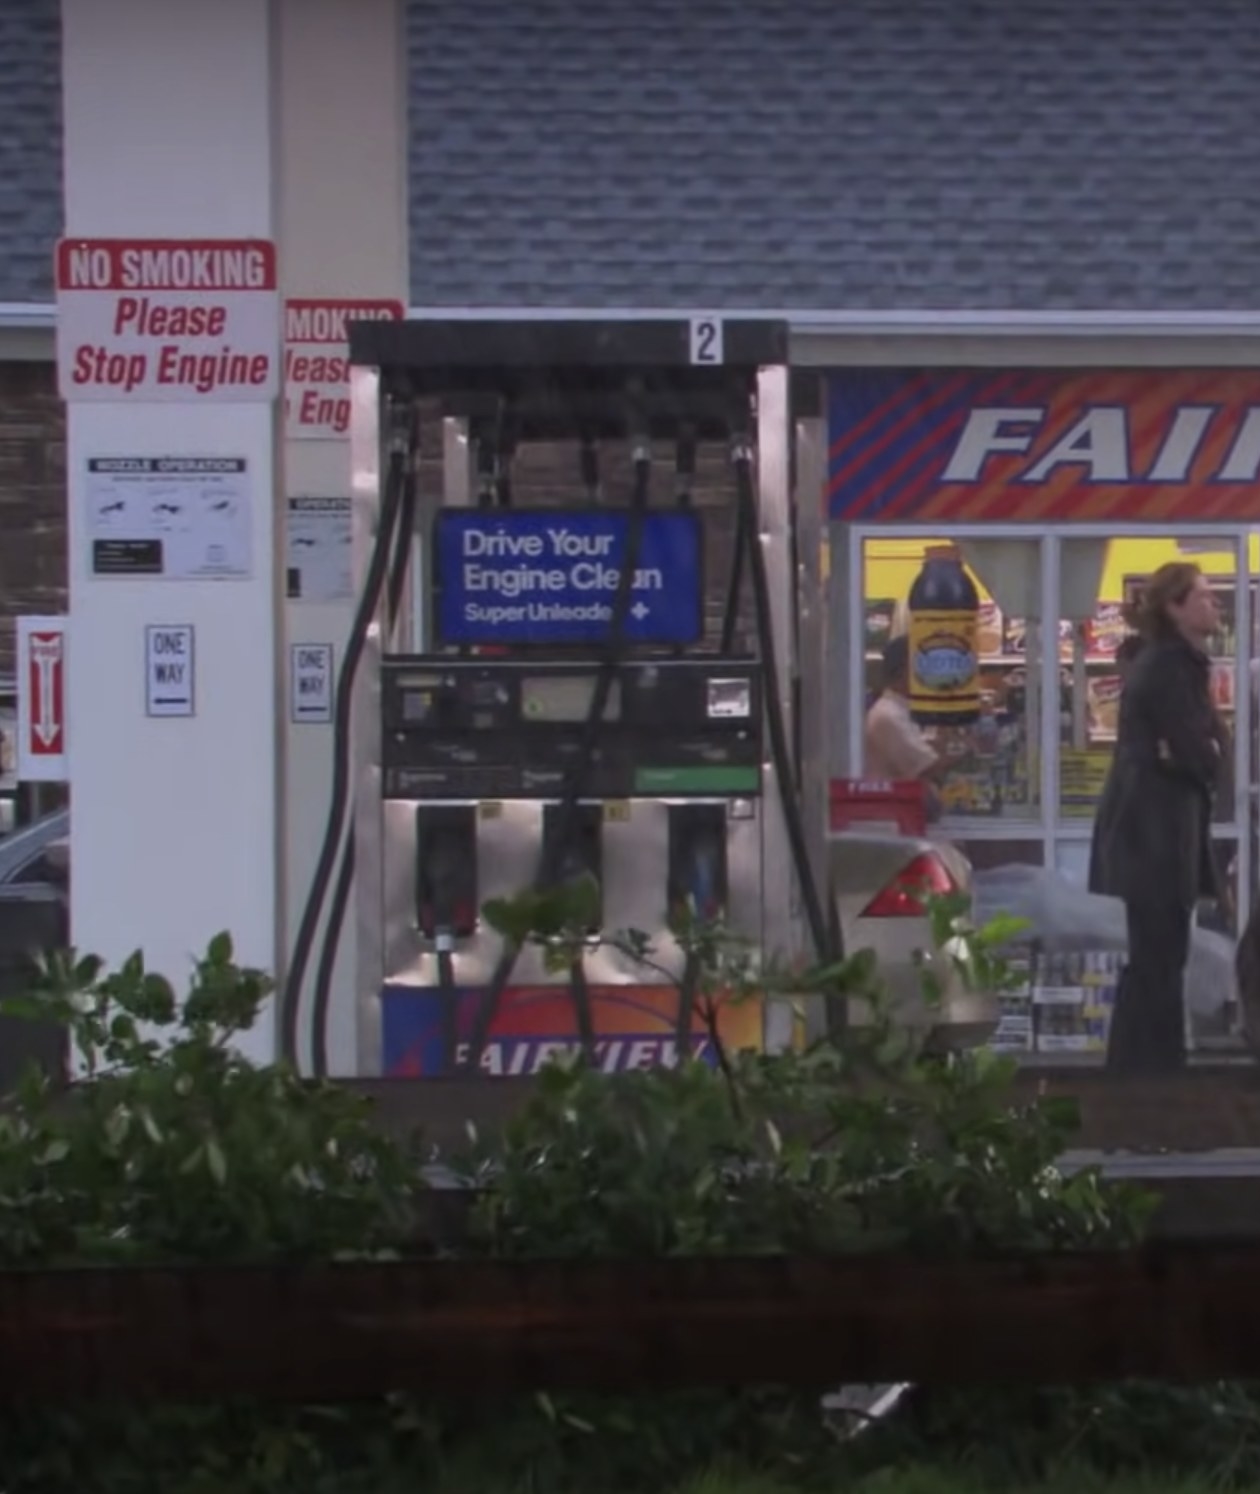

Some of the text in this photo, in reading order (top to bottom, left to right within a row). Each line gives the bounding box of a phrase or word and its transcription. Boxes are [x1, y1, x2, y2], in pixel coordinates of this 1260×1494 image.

[70, 248, 265, 287] NO SMOKING
[114, 298, 227, 336] Please
[697, 321, 717, 361] 2
[72, 345, 269, 393] Stop Engine
[300, 391, 351, 432] Eng
[157, 460, 238, 471] OPERATION
[463, 529, 614, 556] Drive Your
[464, 563, 566, 597] Engine
[465, 603, 526, 625] Super
[153, 632, 186, 656] ONE
[299, 649, 325, 670] ONE
[153, 662, 185, 686] WAY
[299, 676, 325, 695] WAY
